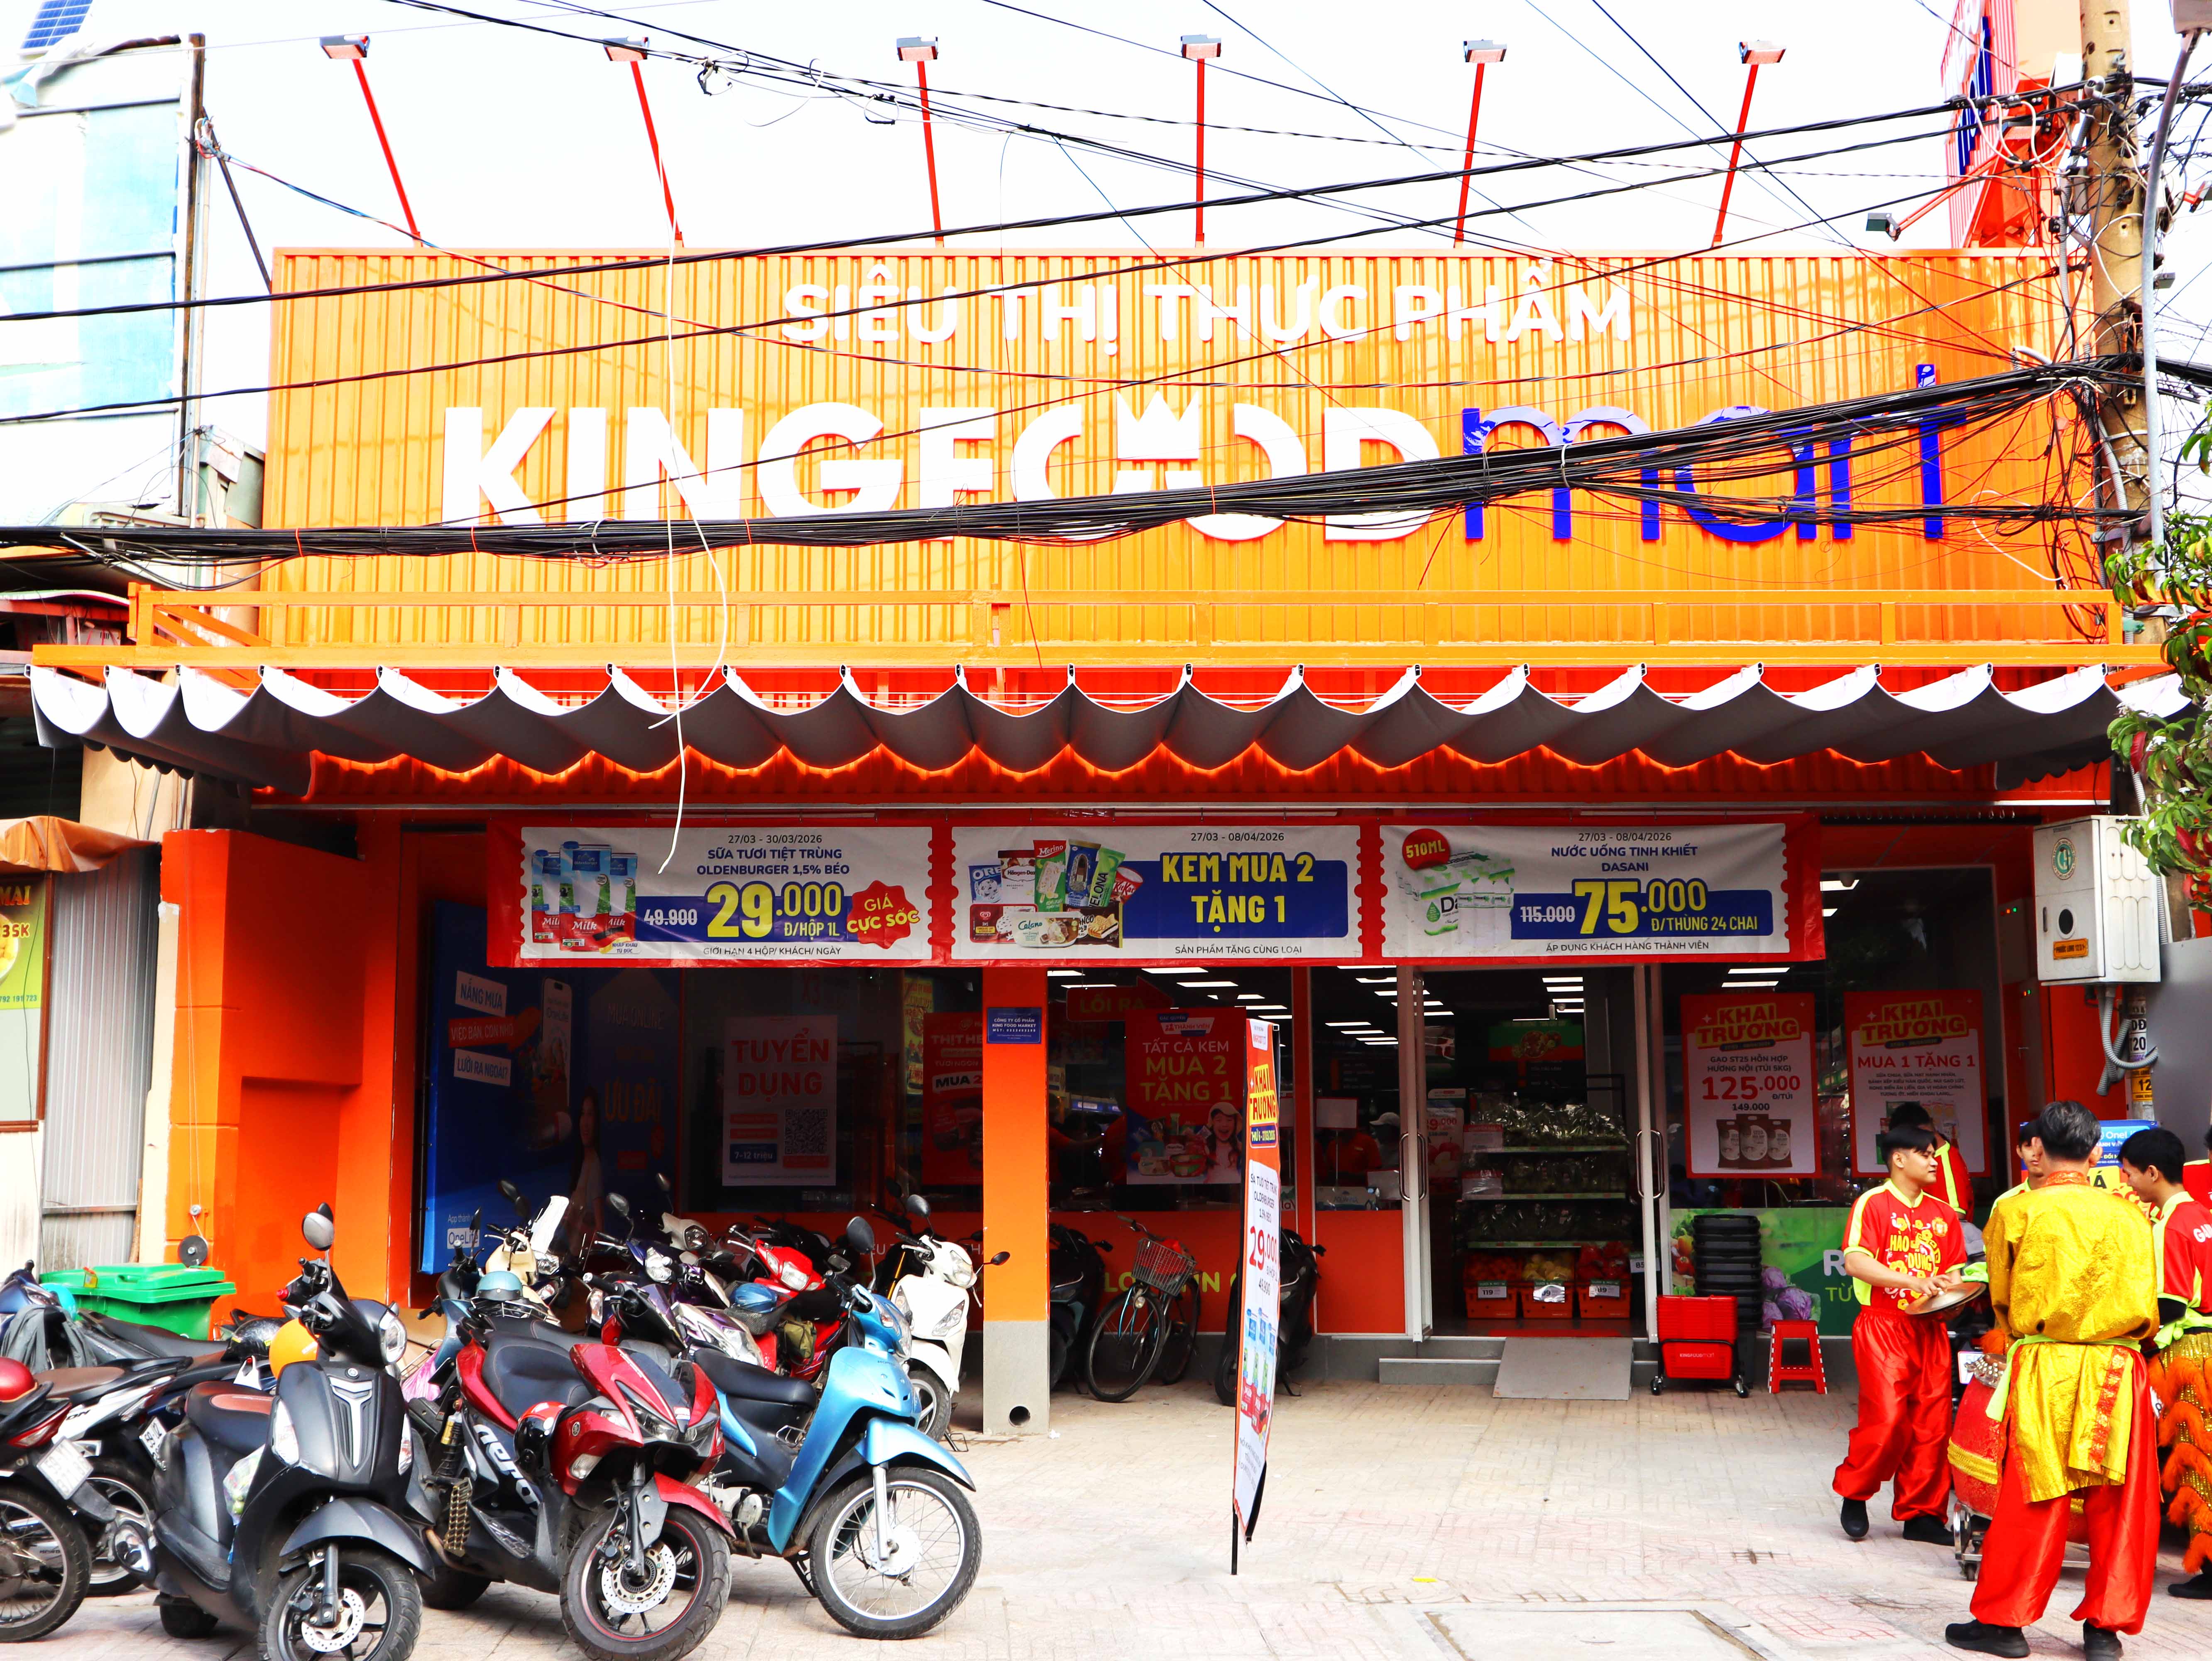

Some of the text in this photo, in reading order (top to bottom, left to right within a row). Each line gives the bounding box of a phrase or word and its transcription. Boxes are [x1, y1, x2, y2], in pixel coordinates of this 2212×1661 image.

[782, 257, 1630, 356] SIÊU THỊ THỰC PHẨM
[728, 835, 755, 844] 27/03
[766, 835, 822, 843] 30/03/2026
[1191, 833, 1218, 841] 27/03
[1229, 833, 1284, 841] 08/04/2026
[1576, 831, 1608, 841] 27/03
[1614, 831, 1673, 841] 08/04/2026
[708, 846, 842, 861] SỮA TƯƠI TIỆT TRÙNG
[1040, 844, 1064, 856] Merino
[1405, 840, 1445, 858] 510ML
[1551, 843, 1698, 857] NƯỚC UỐNG TINH KHIẾT
[697, 862, 849, 876] OLDENBURGER 1,5% BÉO
[973, 867, 1001, 881] ORE
[1163, 852, 1315, 882] KEM MUA 2
[1602, 862, 1648, 871] DASANI
[1113, 880, 1135, 894] KitKat
[707, 883, 842, 938] 29.000
[864, 893, 893, 911] GIÁ
[1192, 890, 1285, 932] TẶNG 1
[1575, 881, 1706, 934] 75.000
[542, 917, 559, 926] Mil
[644, 909, 697, 928] 49.900
[847, 905, 920, 934] CỰC SỐC
[1520, 906, 1575, 922] 115.000
[1652, 914, 1757, 931] Đ/THÙNG 24 CHAI
[572, 921, 598, 930] Milk
[784, 919, 839, 940] Đ/HỘP 1L
[1018, 920, 1042, 931] Celano
[729, 947, 745, 956] HẠN
[755, 946, 777, 956] HỘP/
[780, 946, 814, 955] KHÁCH/
[1176, 945, 1194, 953] SẢN
[1197, 944, 1223, 953] PHẨM
[1226, 945, 1250, 955] TẶNG
[1253, 945, 1278, 953] CÙNG
[1546, 943, 1558, 951] ÁP
[1590, 941, 1622, 950] KHÁCH
[1625, 941, 1651, 950] HÀNG
[1654, 941, 1686, 949] THÀNH
[1688, 940, 1708, 949] VIÊN
[461, 978, 502, 1009] NẮNG MƯA
[1080, 990, 1112, 1014] LỐI
[1720, 1005, 1774, 1024] KHAI
[1884, 1002, 1940, 1022] KHAI
[1698, 1021, 1796, 1044] TRƯƠNG
[1862, 1017, 1964, 1041] TRƯƠNG
[731, 1027, 830, 1063] TUYỂN
[1143, 1038, 1229, 1054] TẤT CẢ KEM
[458, 1056, 507, 1079] LƯỜI RA NGOÀI?
[1146, 1055, 1227, 1075] MUA 2
[1858, 1052, 1975, 1070] MUA 1 TẶNG 1
[738, 1072, 822, 1102] DỤNG
[936, 1076, 970, 1088] MUA
[1255, 1066, 1270, 1094] KHAI
[1702, 1076, 1800, 1100] 125.000
[1139, 1077, 1233, 1106] TẶNG 1
[754, 1150, 773, 1163] triệu
[448, 1214, 458, 1225] App
[1890, 1230, 1909, 1252] HÀO
[1908, 1249, 1932, 1271] DŨNG
